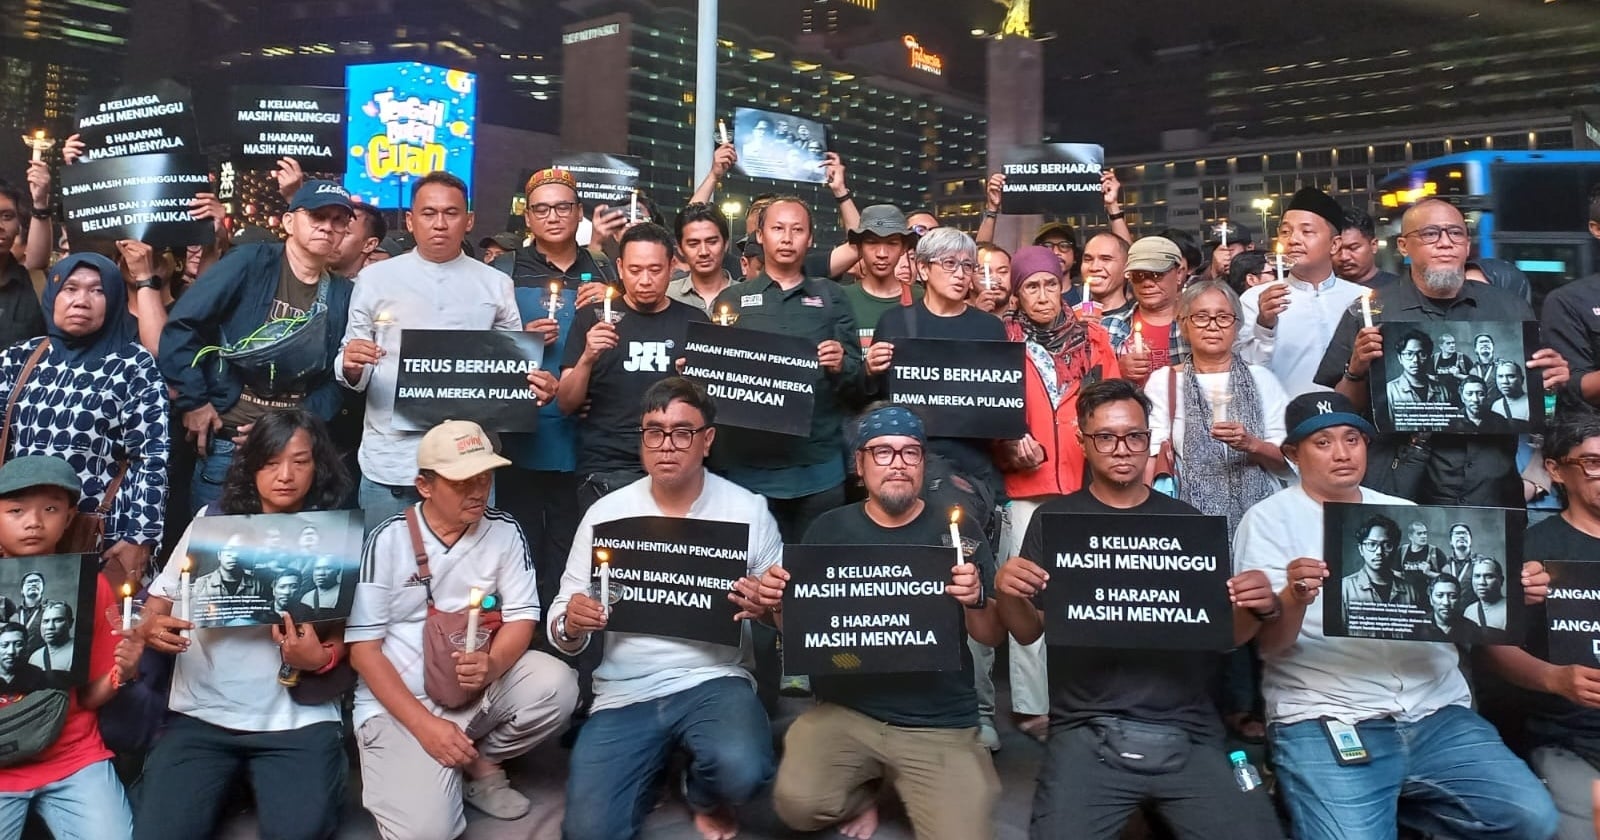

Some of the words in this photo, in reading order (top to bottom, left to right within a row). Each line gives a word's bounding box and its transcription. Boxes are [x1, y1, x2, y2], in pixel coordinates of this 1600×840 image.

[100, 103, 106, 112] 8
[107, 95, 160, 111] KELUARGA
[259, 99, 266, 109] 8
[267, 100, 319, 110] KELUARGA
[80, 113, 115, 128] MASIH
[116, 101, 184, 122] MENUNGGU
[238, 110, 272, 121] MASIH
[273, 111, 341, 124] MENUNGGU
[105, 135, 113, 144] 8
[114, 128, 163, 143] HARAPAN
[259, 132, 266, 142] 8
[267, 132, 314, 143] HARAPAN
[89, 146, 126, 160] MASIH
[129, 136, 184, 154] MENYALA
[243, 144, 276, 154] MASIH
[277, 144, 333, 157] MENYALA
[1004, 164, 1039, 174] TERUS
[1041, 163, 1102, 174] BERHARAP
[70, 184, 91, 195] JIWA
[92, 178, 121, 190] MASIH
[123, 175, 177, 186] MENUNGGU
[178, 174, 209, 183] KABAR
[1003, 184, 1028, 192] BAWA
[1030, 183, 1065, 192] MEREKA
[1066, 183, 1102, 192] PULANG
[75, 203, 118, 218] JURNALIS
[118, 200, 139, 210] DAN
[148, 198, 178, 207] AWAK
[82, 215, 122, 232] BELUM
[685, 342, 722, 355] JANGAN
[723, 348, 767, 362] HENTIKAN
[768, 354, 818, 369] PENCARIAN
[403, 358, 452, 373] TERUS
[455, 359, 538, 373] BERHARAP
[682, 366, 725, 380] JANGAN
[726, 372, 771, 388] BIARKAN
[772, 379, 814, 394] MEREKA
[894, 366, 940, 380] TERUS
[943, 367, 1023, 383] BERHARAP
[398, 387, 434, 398] BAWA
[436, 387, 486, 399] MEREKA
[489, 388, 537, 399] PULANG
[707, 384, 785, 407] DILUPAKAN
[893, 393, 927, 405] BAWA
[928, 394, 975, 406] MEREKA
[976, 396, 1024, 409] PULANG
[592, 537, 634, 550] JANGAN
[636, 541, 687, 555] HENTIKAN
[689, 545, 747, 561] PENCARIAN
[1089, 536, 1099, 549] 8
[1102, 536, 1182, 551] KELUARGA
[1056, 552, 1111, 569] MASIH
[1114, 554, 1217, 571] MENUNGGU
[592, 566, 640, 581] JNGAN
[643, 570, 695, 586] BIARKAN
[696, 575, 736, 590] MEREK
[826, 566, 835, 579] 8
[838, 565, 912, 579] KELUARGA
[623, 586, 712, 610] DILUPAKAN
[794, 583, 846, 598] MASIH
[850, 581, 945, 597] MENUNGGU
[1095, 588, 1105, 601] 8
[1108, 588, 1180, 603] HARAPAN
[830, 615, 840, 628] 8
[842, 614, 910, 628] HARAPAN
[1067, 604, 1123, 621] MASIH
[1127, 606, 1210, 624] MENYALA
[804, 632, 857, 648] MASIH
[860, 630, 938, 646] MENYALA
